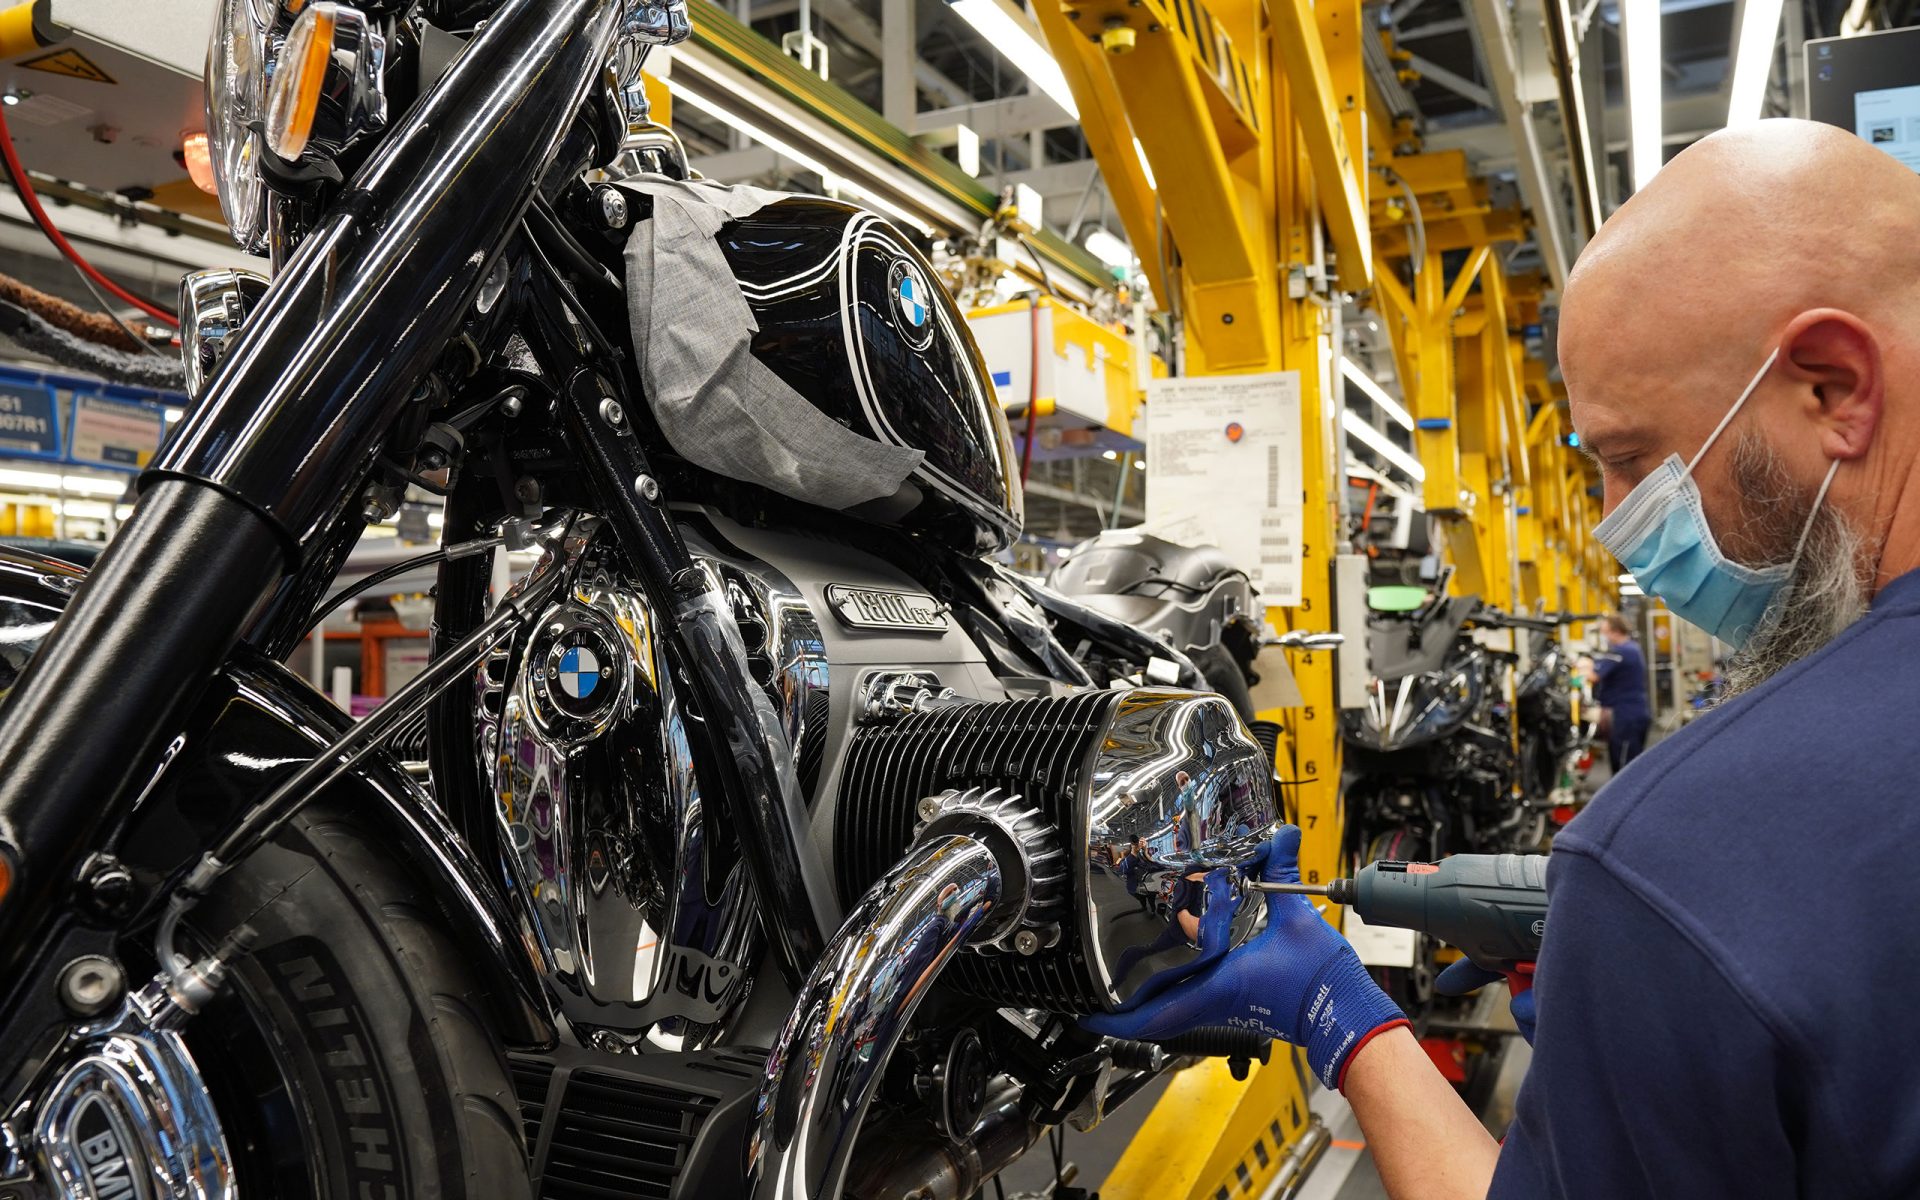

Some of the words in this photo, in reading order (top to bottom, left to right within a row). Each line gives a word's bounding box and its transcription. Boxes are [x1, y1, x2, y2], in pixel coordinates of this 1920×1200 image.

[0, 411, 47, 434] 07R1
[1302, 544, 1310, 558] 2
[1302, 598, 1311, 612] 3
[1302, 653, 1313, 666] 4
[1304, 706, 1315, 720] 5
[1305, 761, 1316, 775] 6
[1307, 816, 1318, 829] 7
[1308, 870, 1319, 884] 8
[1307, 984, 1329, 1024] Ansell
[80, 1129, 137, 1200] BM
